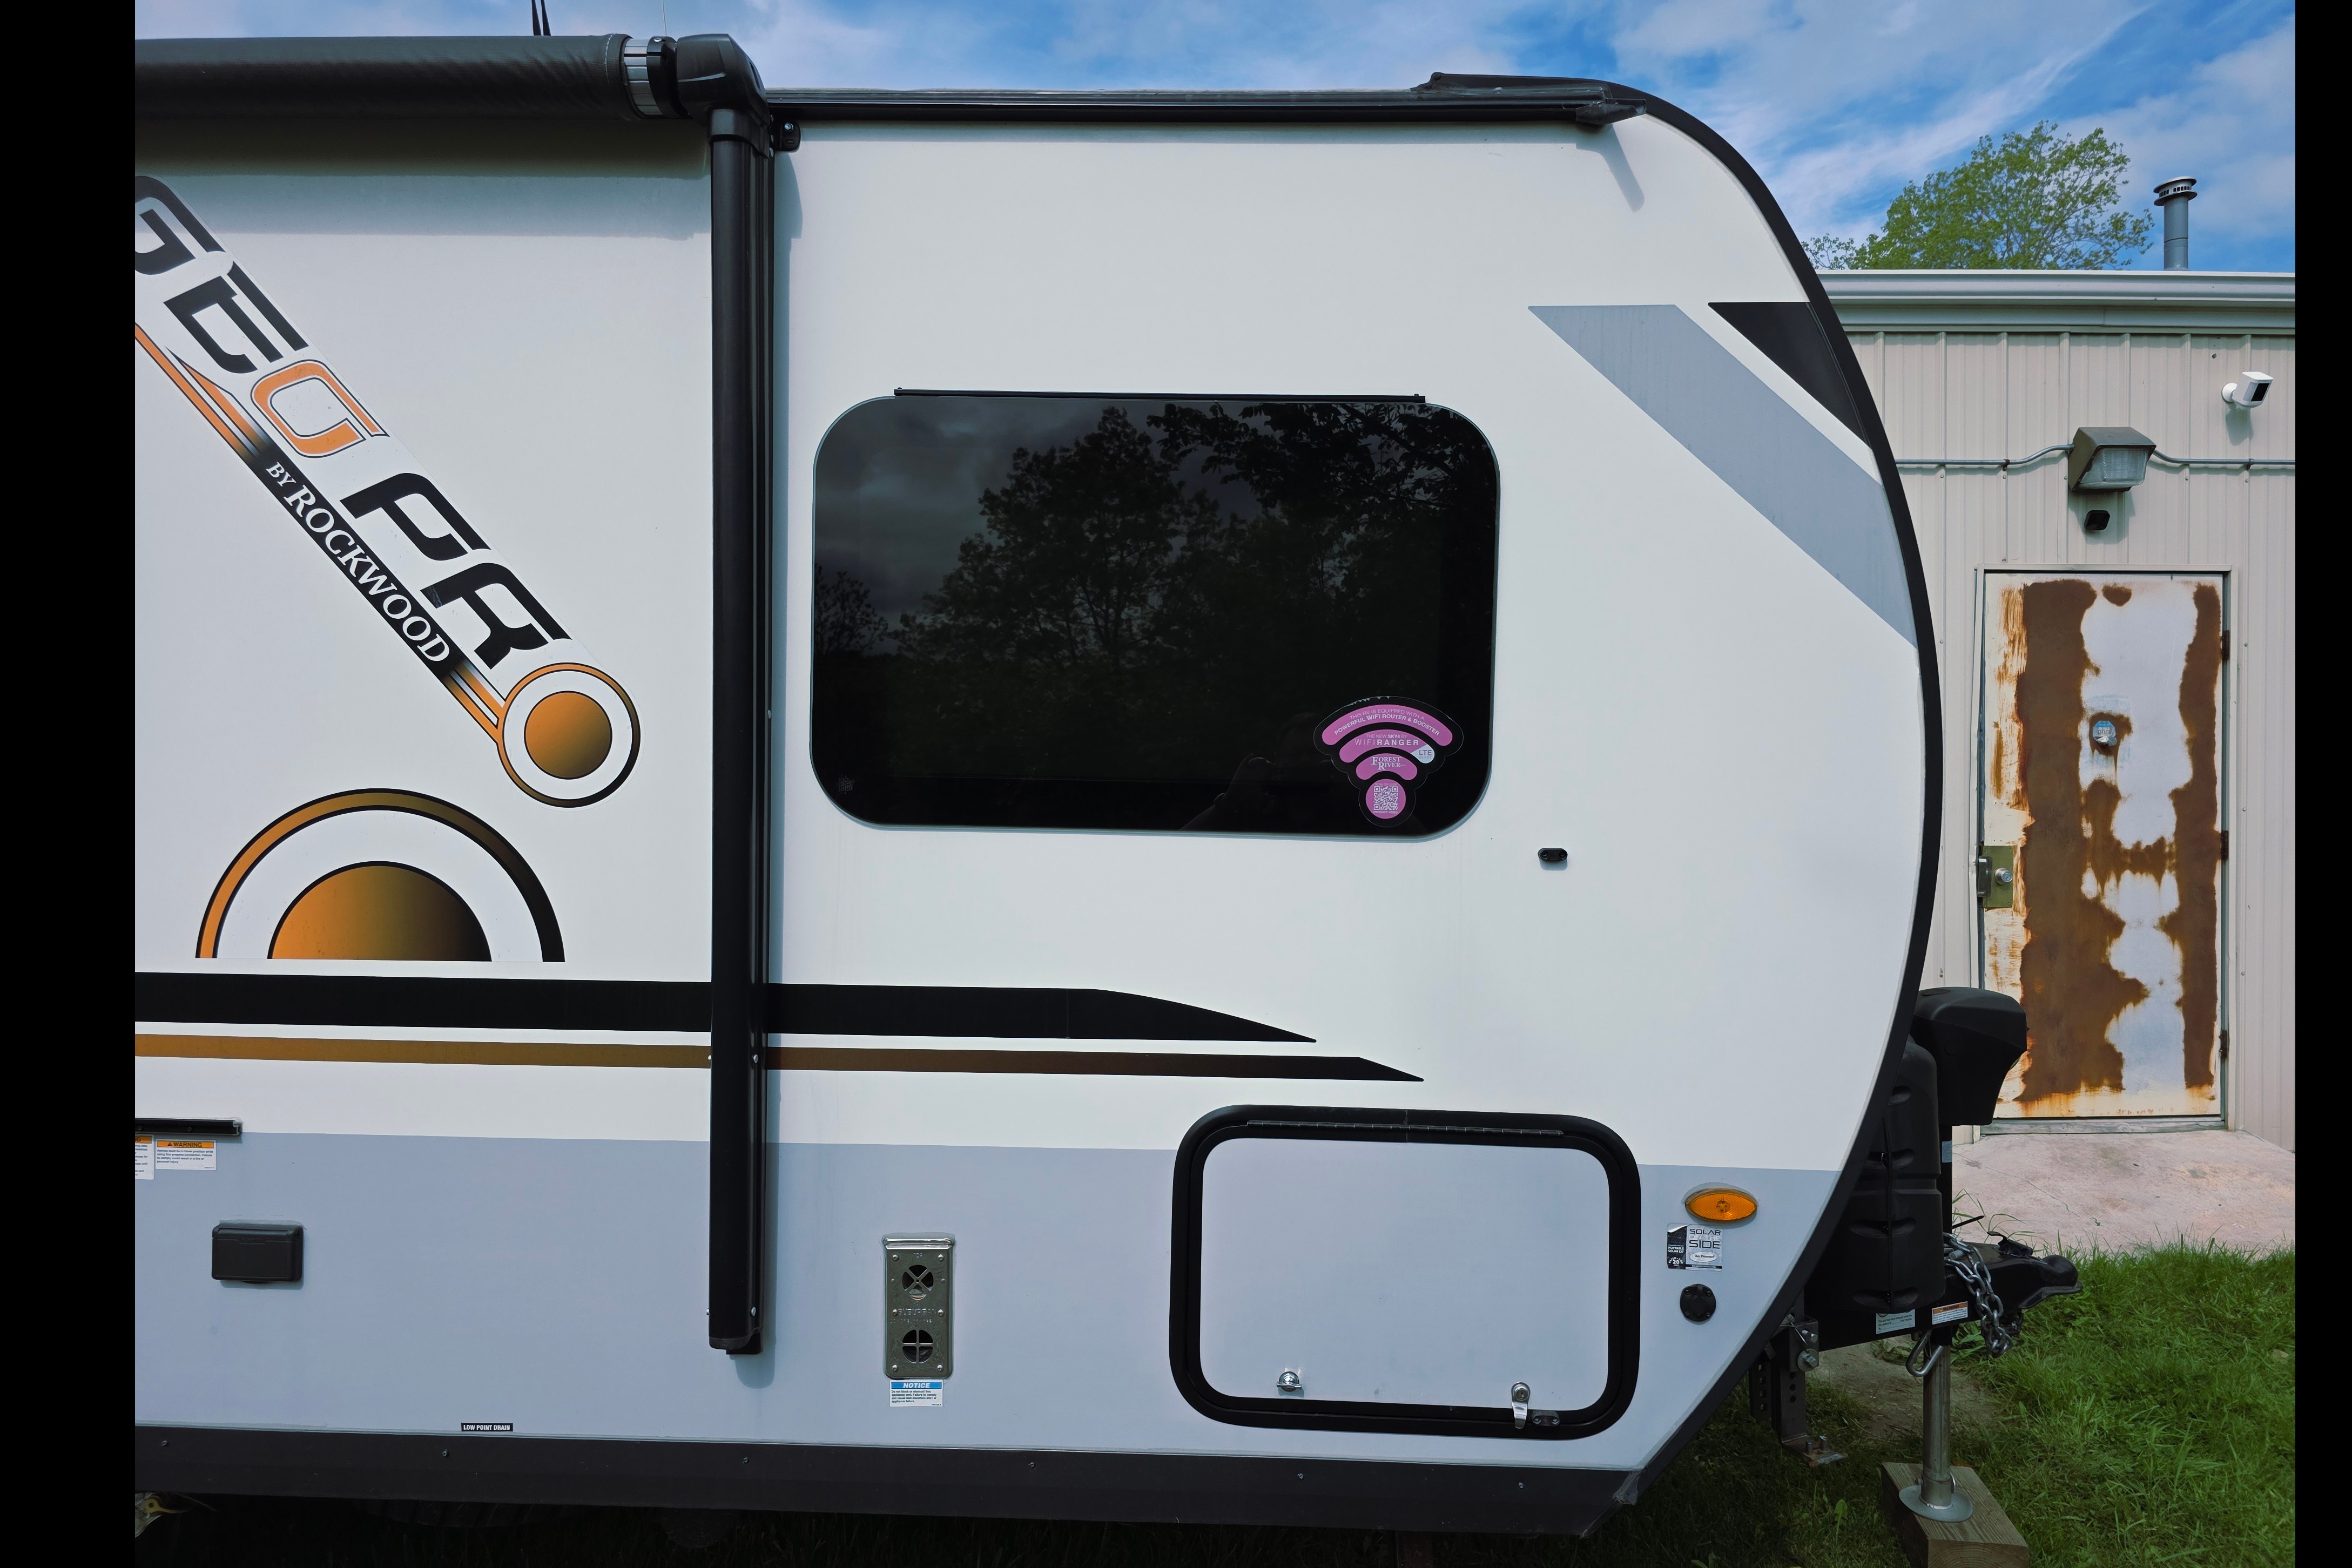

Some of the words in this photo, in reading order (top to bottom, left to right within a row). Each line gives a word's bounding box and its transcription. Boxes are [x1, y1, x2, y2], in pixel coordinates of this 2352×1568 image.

[266, 462, 296, 489] BY
[284, 484, 450, 662] ROCKWOOD
[1334, 718, 1366, 735] POWERFUL
[1413, 719, 1440, 736] BOOSTER
[1372, 756, 1402, 765] FOREST
[1377, 762, 1401, 771] RIVER
[1689, 1240, 1720, 1249] SIDE
